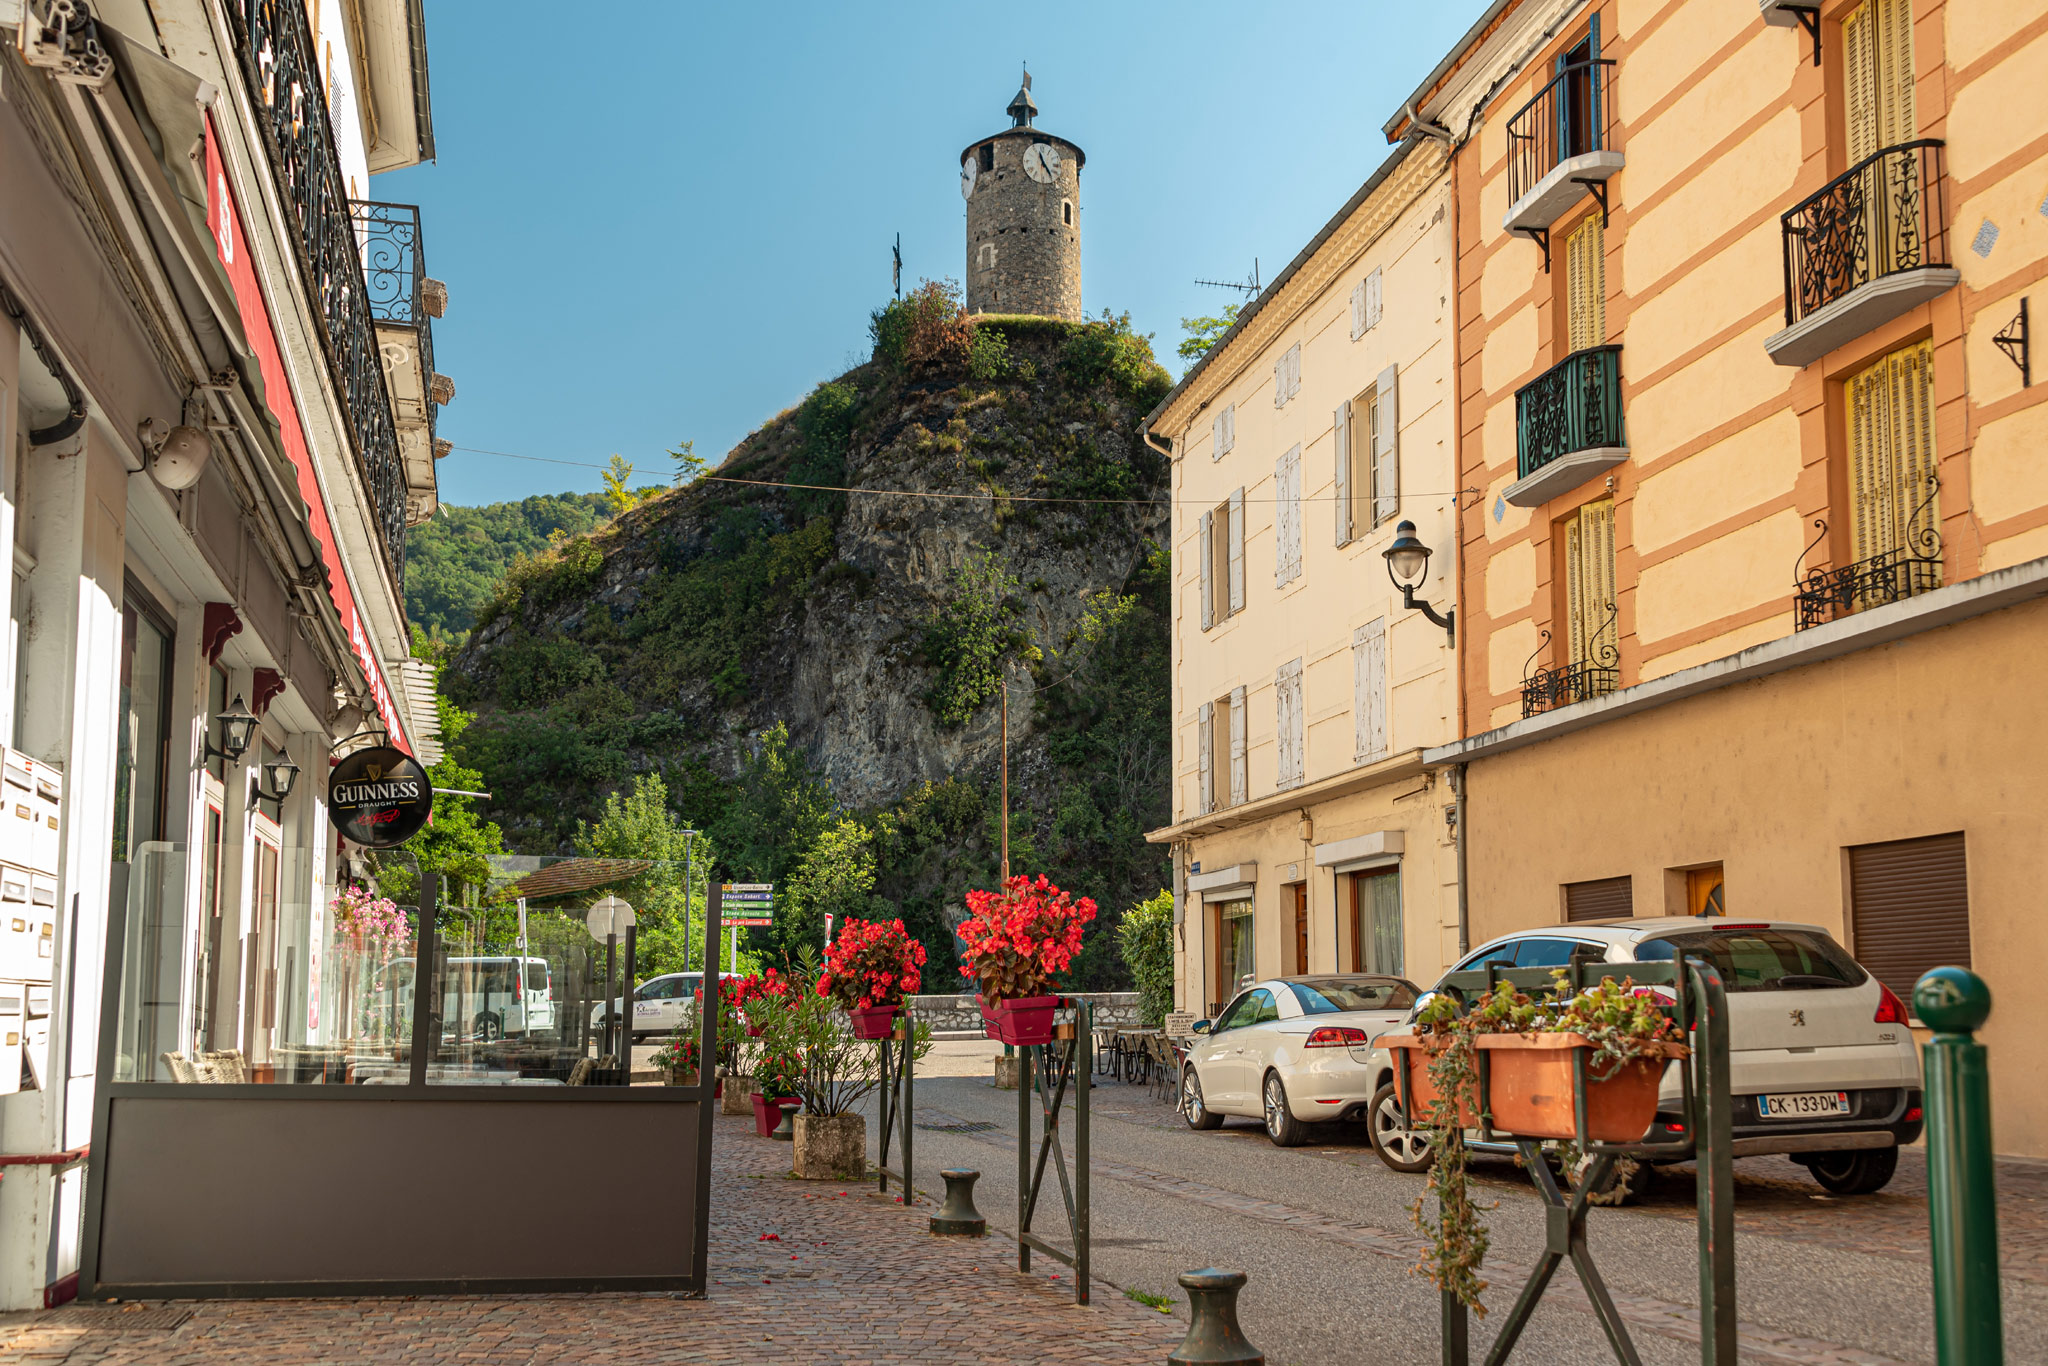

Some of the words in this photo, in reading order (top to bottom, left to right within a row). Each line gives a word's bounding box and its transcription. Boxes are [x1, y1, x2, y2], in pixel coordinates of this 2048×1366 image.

[333, 782, 419, 803] GUINNESS
[358, 801, 397, 809] DRAUGHT
[1769, 1096, 1838, 1114] CK-133-DW
